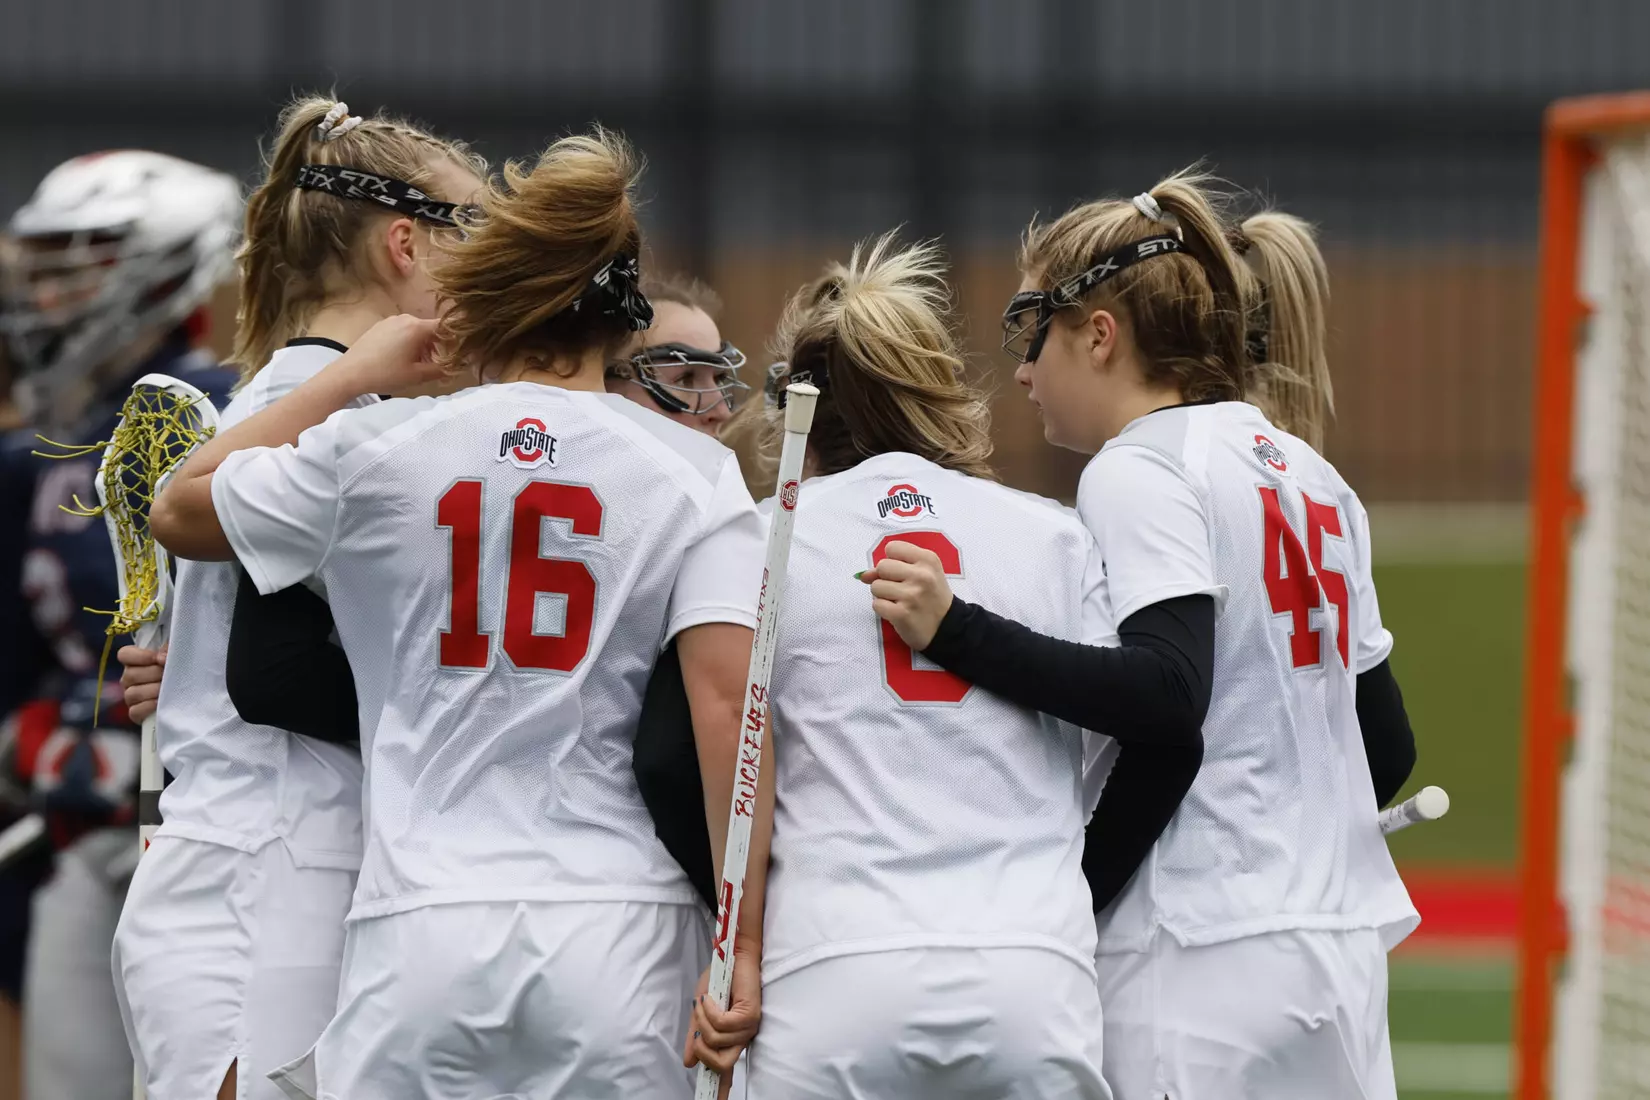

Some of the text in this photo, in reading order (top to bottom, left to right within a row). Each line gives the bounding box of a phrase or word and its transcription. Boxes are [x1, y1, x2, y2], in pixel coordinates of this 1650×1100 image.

[339, 170, 391, 193] STX
[1061, 256, 1119, 300] STX
[434, 476, 608, 678] 16
[1254, 483, 1349, 674] 45
[735, 683, 769, 817] BUCKEYES
